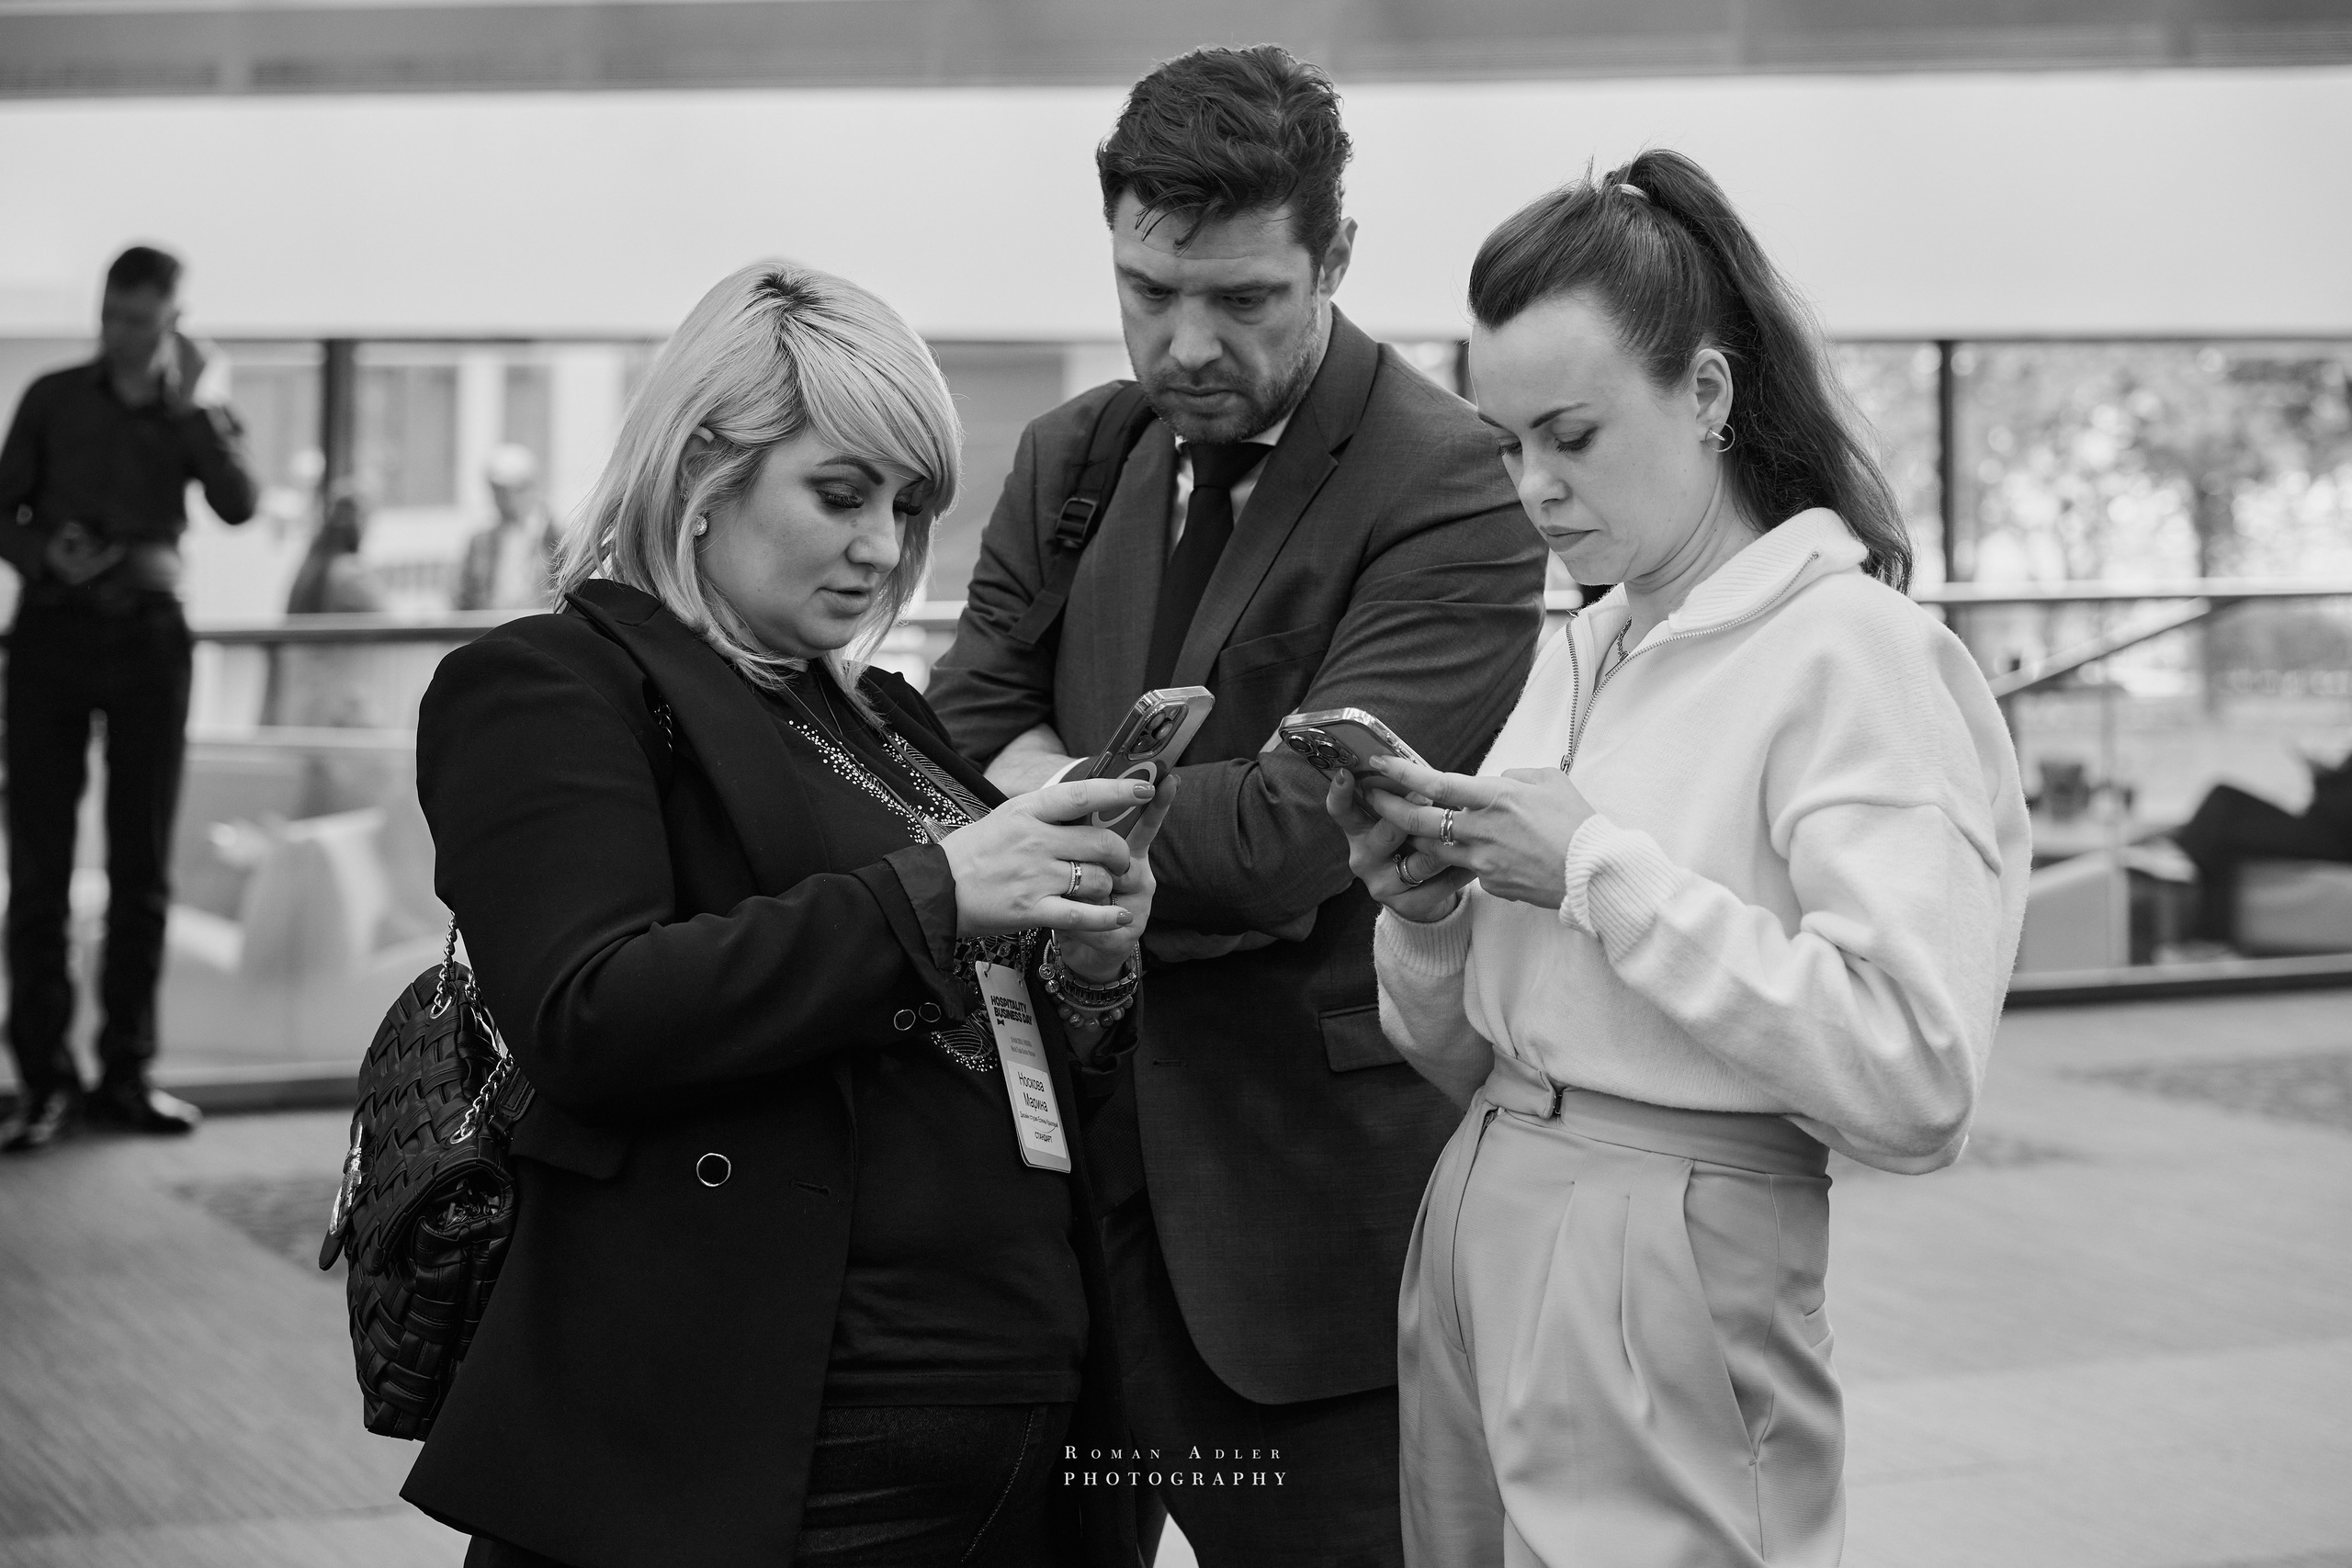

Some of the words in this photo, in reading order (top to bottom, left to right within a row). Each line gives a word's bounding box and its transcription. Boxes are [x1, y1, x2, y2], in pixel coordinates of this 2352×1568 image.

[990, 995, 1027, 1013] HOSPITALITY
[994, 1007, 1023, 1023] BUSINESS
[1018, 1071, 1045, 1092] Носкова
[1023, 1091, 1048, 1111] Марина
